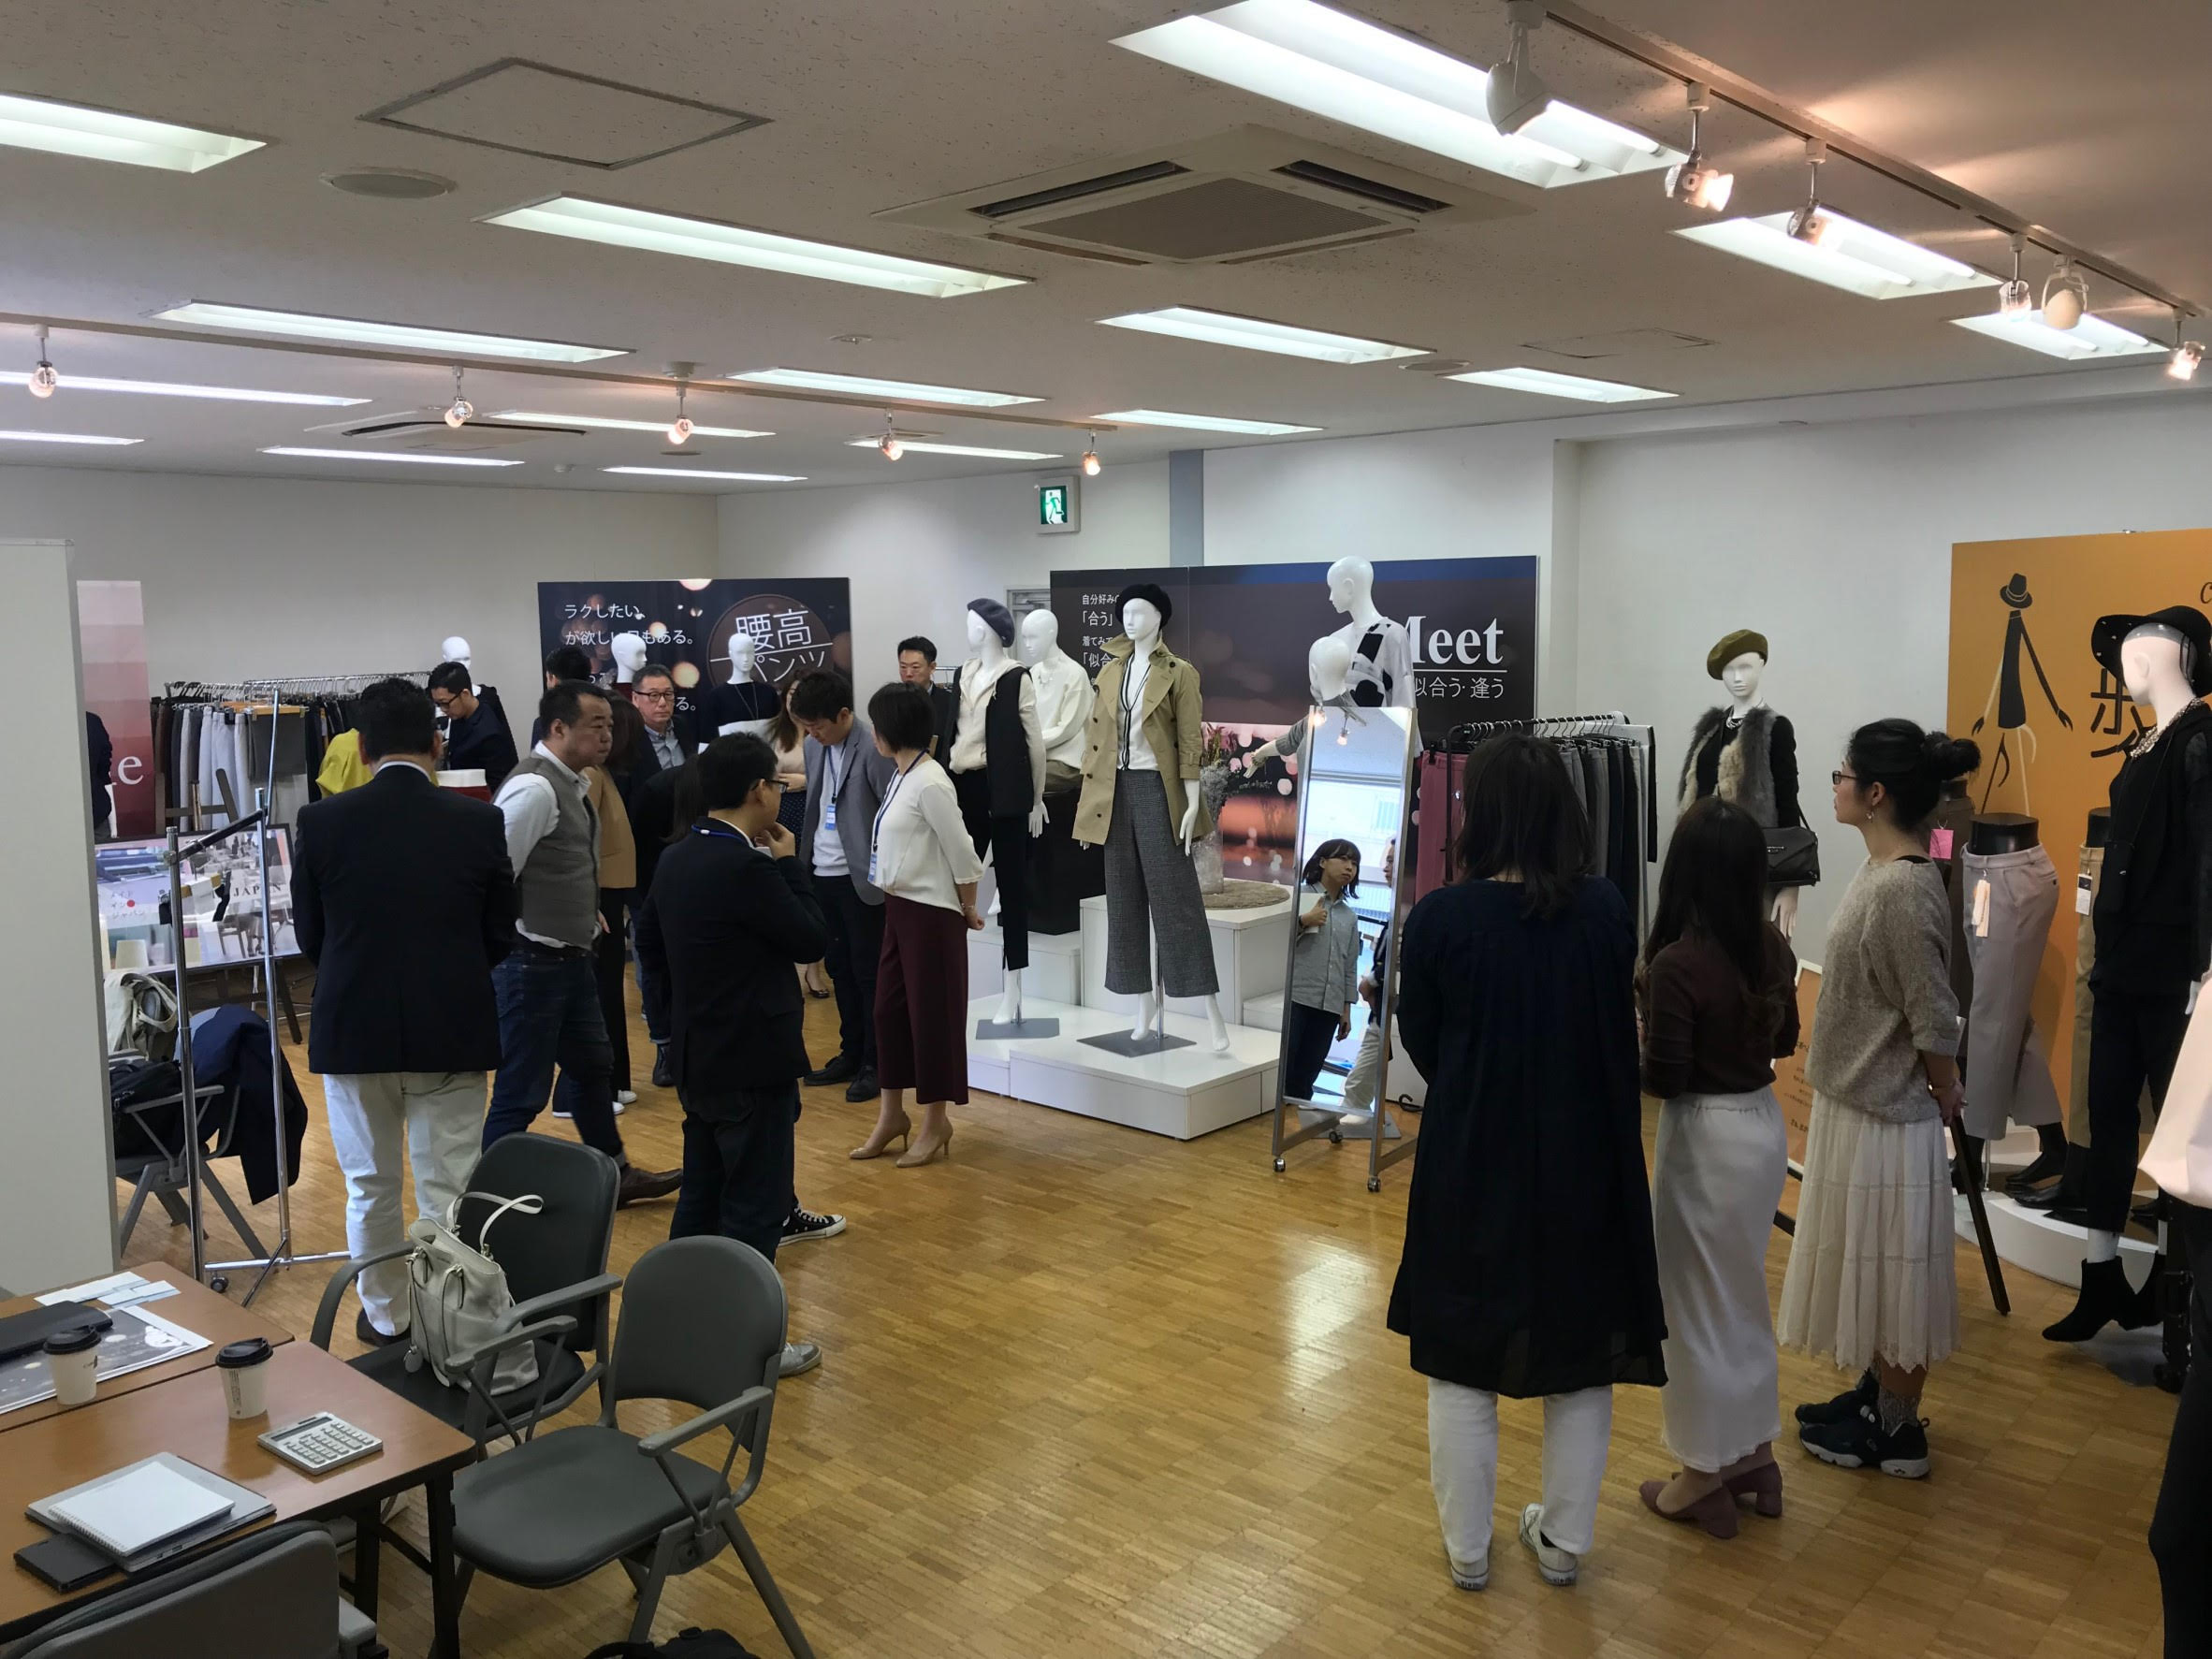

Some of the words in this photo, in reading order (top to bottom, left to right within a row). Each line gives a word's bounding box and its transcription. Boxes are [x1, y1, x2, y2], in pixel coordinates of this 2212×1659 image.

[1083, 610, 1113, 627] 「合う」
[565, 630, 693, 646] が欲しもある。
[735, 608, 809, 652] 腰高
[233, 883, 282, 897] JAPN
